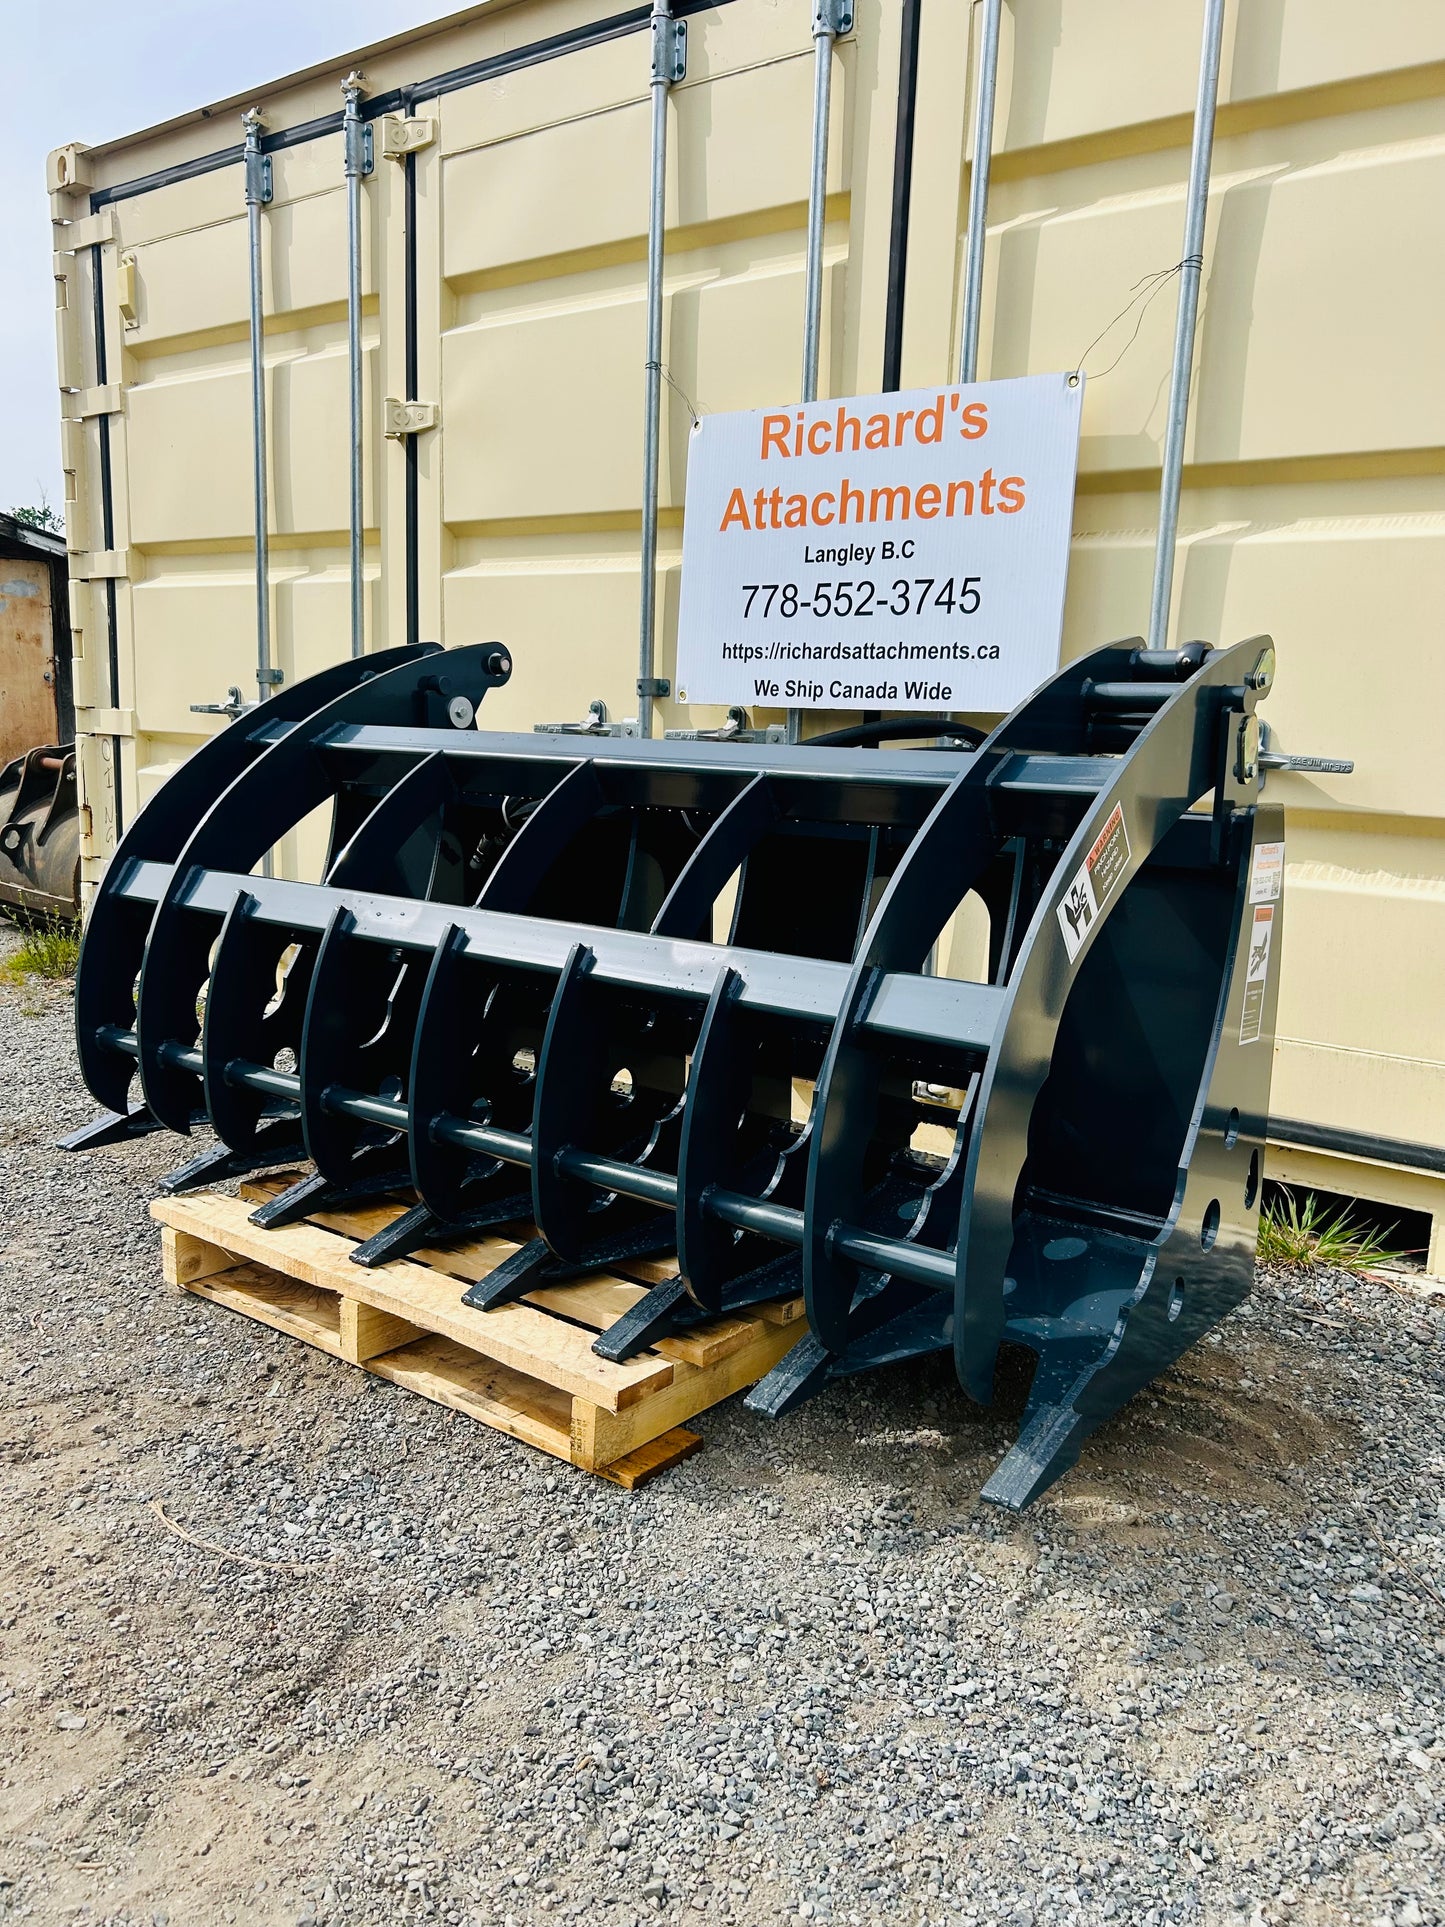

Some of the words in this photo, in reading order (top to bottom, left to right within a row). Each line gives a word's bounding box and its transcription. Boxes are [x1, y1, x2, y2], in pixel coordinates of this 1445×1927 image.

[761, 393, 988, 459] Richard's
[720, 469, 1026, 531] Attachments
[804, 543, 876, 567] Langley
[881, 539, 915, 560] B.C
[742, 576, 982, 619] 778-552-3745
[722, 641, 1000, 664] https://richardsattachments.ca
[754, 679, 780, 697] We
[784, 679, 824, 702] Ship
[829, 680, 898, 700] Canada
[904, 680, 953, 701] Wide
[1094, 811, 1120, 856] WARNING
